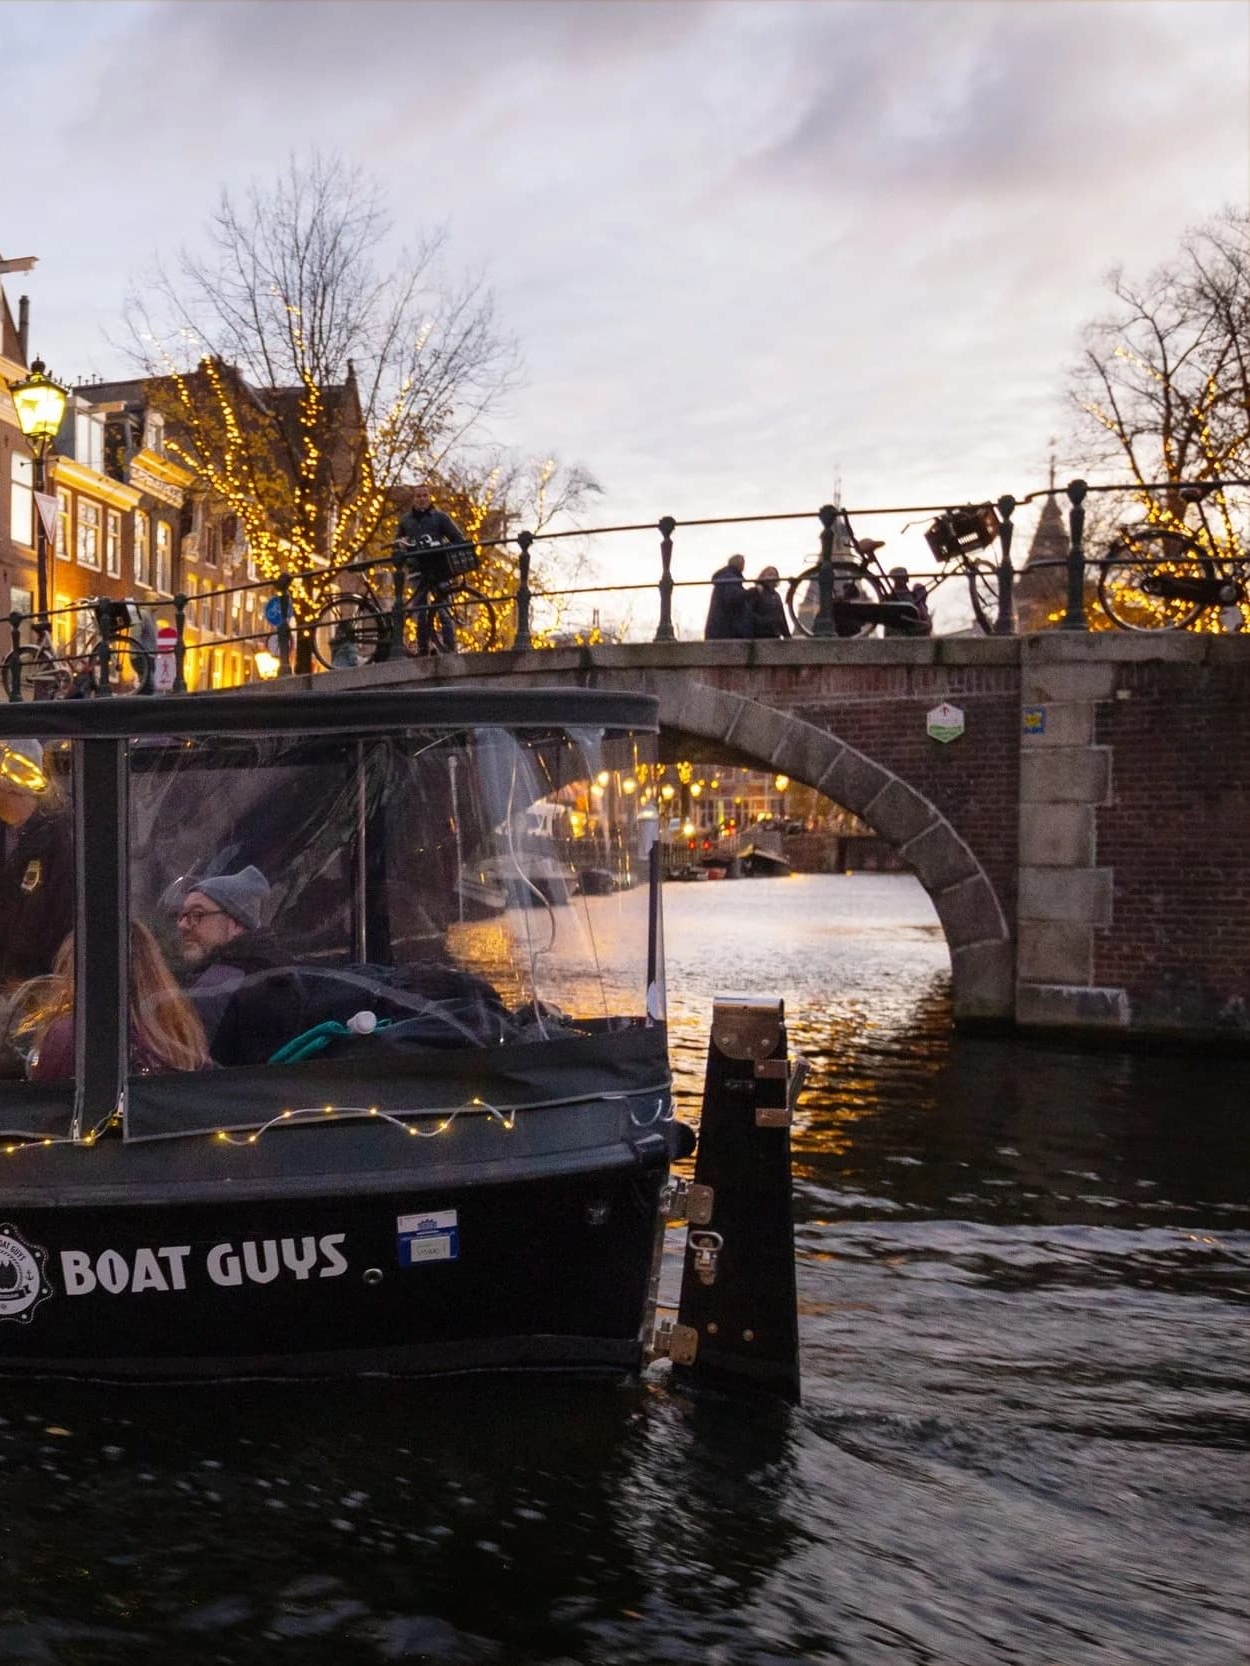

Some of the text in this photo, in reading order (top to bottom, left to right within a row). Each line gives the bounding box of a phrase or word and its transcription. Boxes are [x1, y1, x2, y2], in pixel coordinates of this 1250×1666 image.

[10, 1245, 26, 1261] GUYS
[61, 1246, 191, 1295] BOAT
[207, 1234, 348, 1285] GUYS
